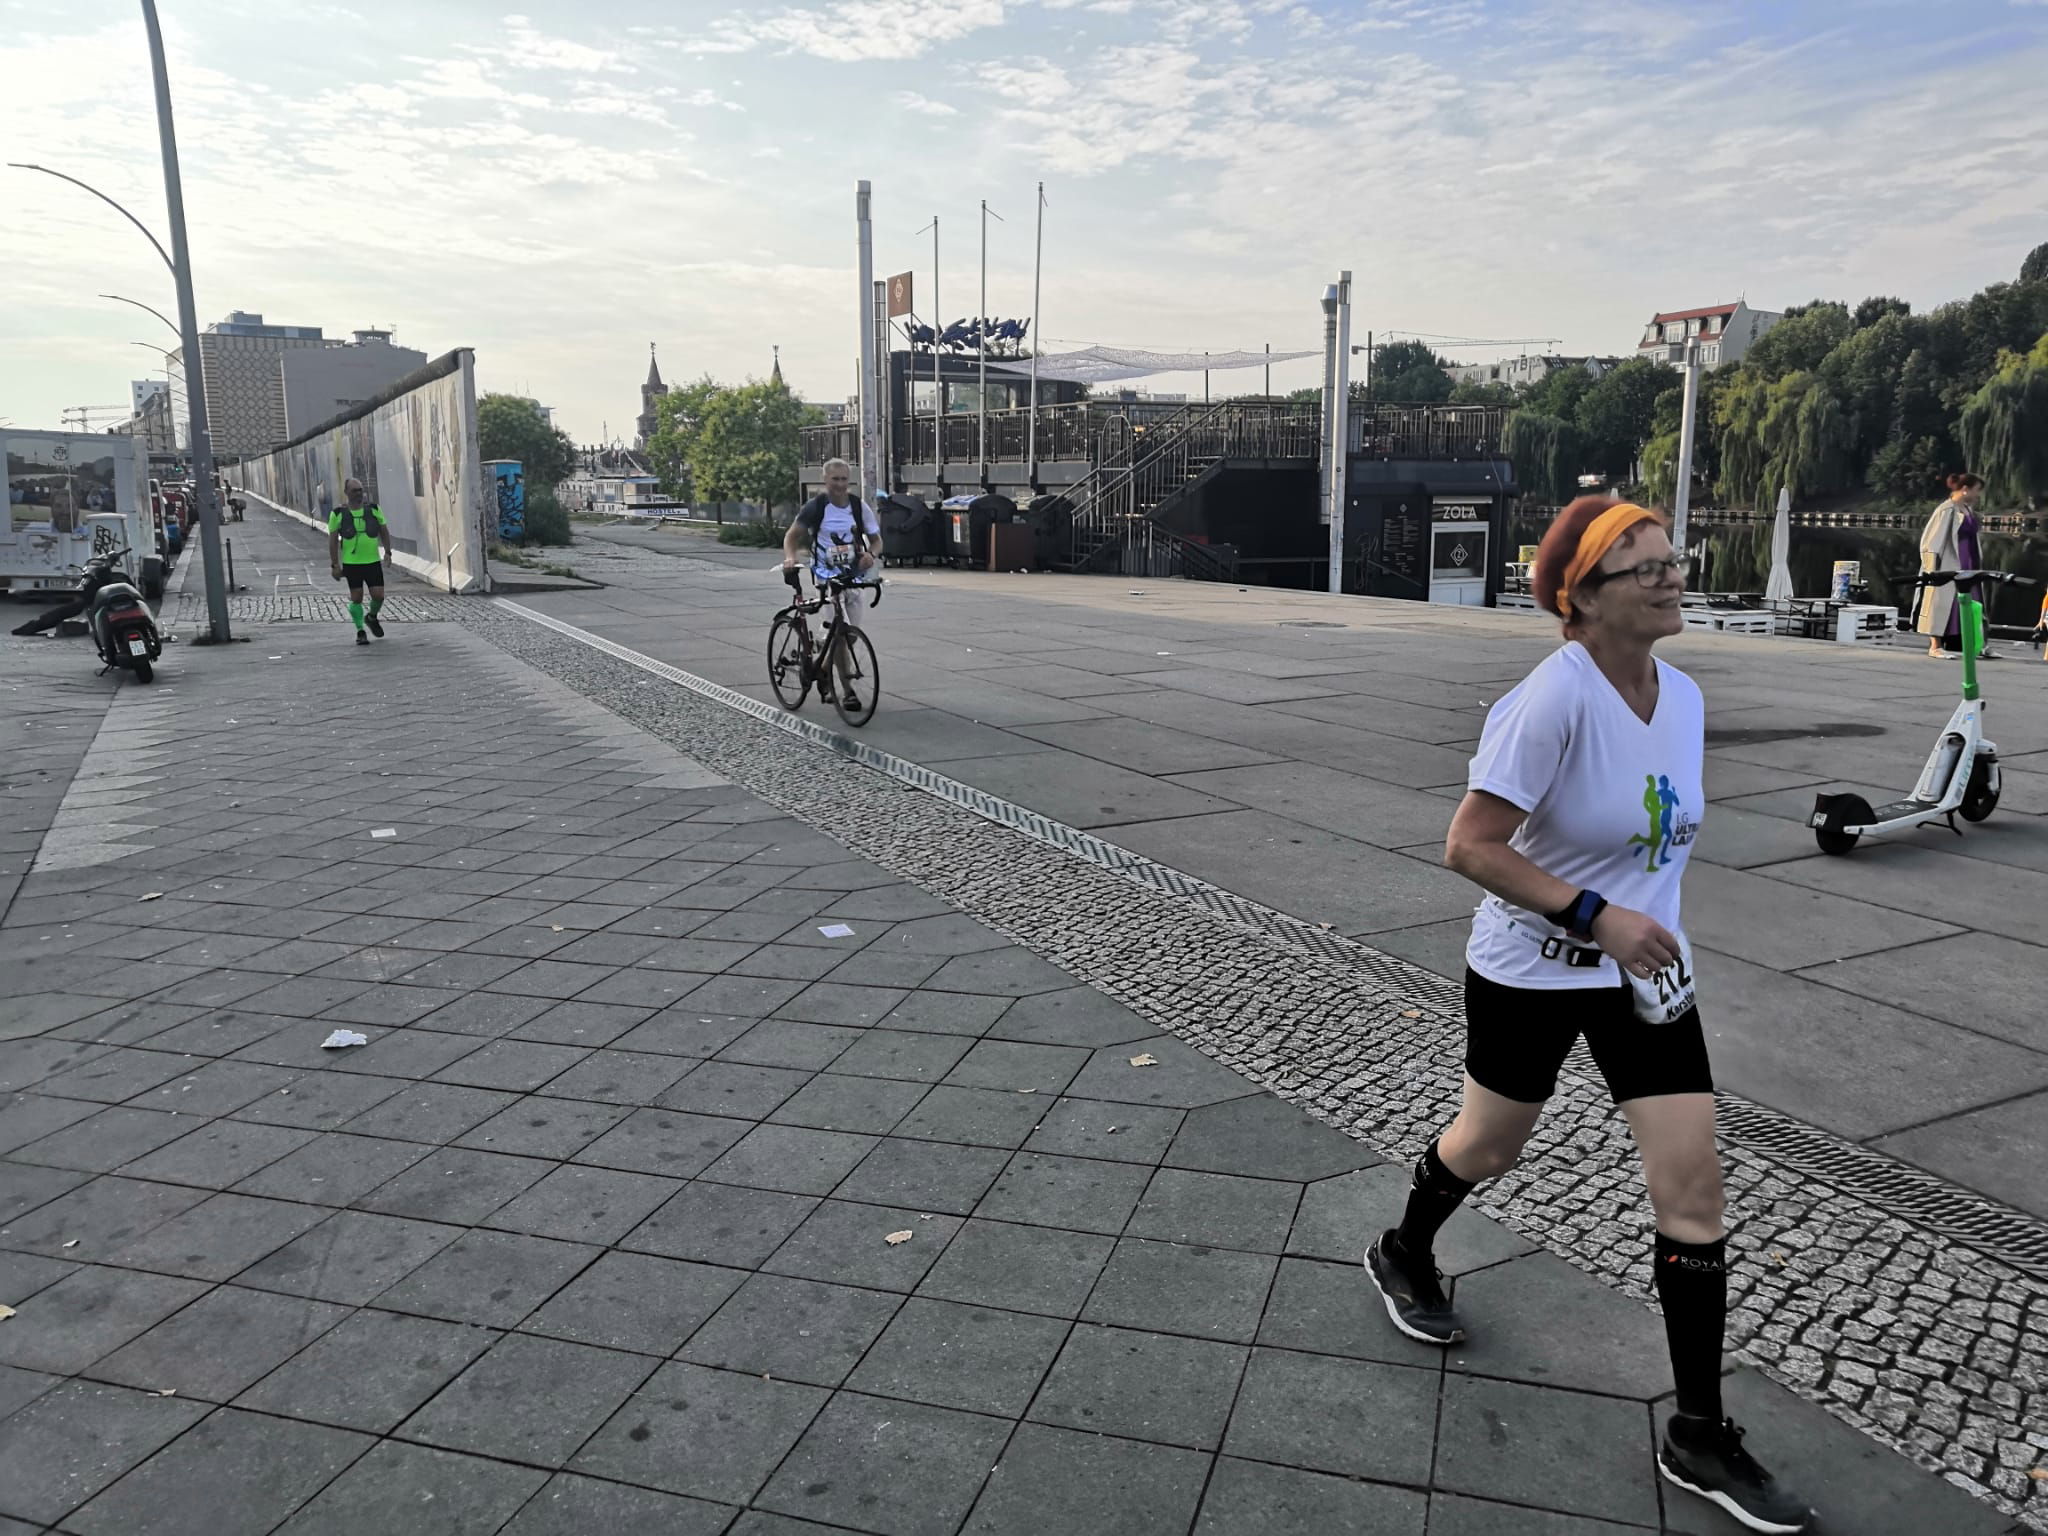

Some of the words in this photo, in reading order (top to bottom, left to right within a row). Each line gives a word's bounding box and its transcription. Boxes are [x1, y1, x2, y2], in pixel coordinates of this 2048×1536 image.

[1442, 505, 1477, 520] ZOLA
[832, 553, 849, 563] 212
[1676, 812, 1689, 825] LG
[1653, 956, 1692, 1006] 212
